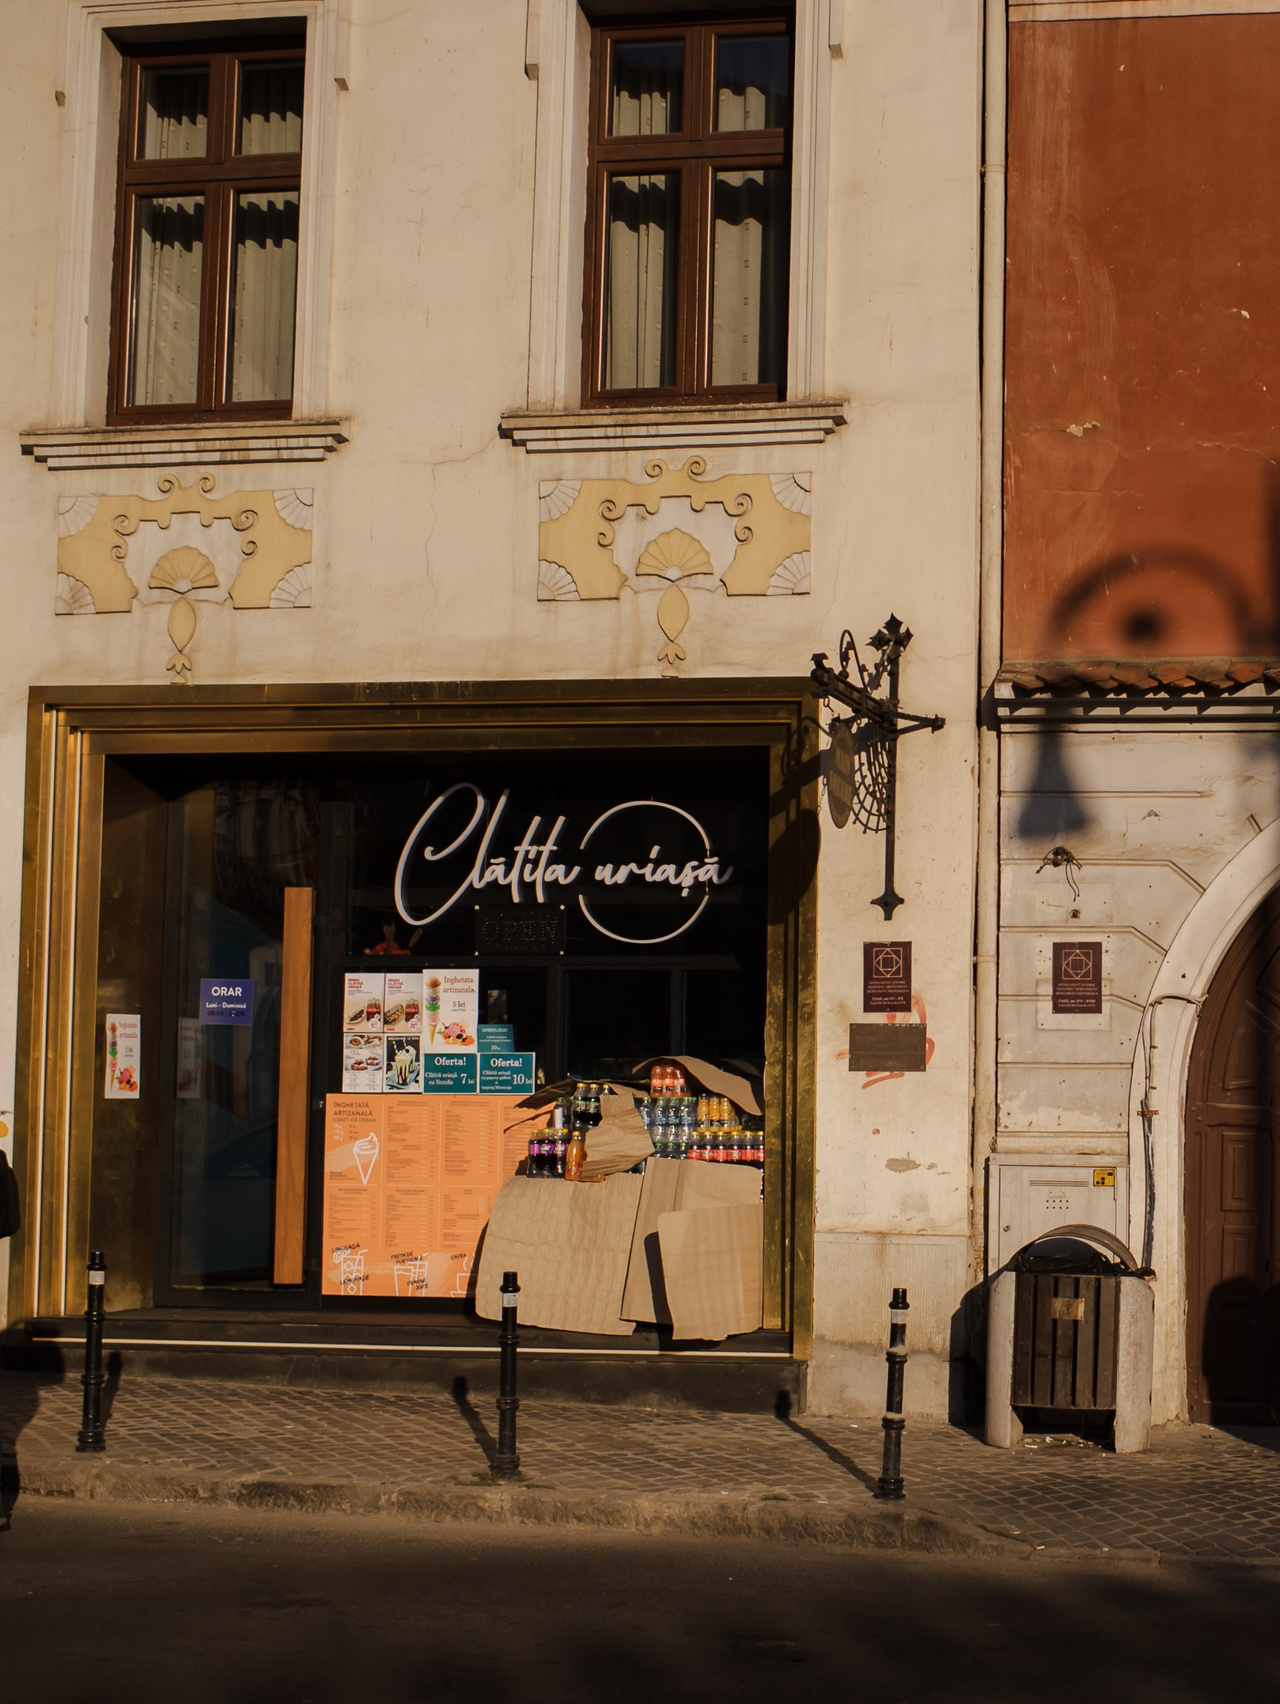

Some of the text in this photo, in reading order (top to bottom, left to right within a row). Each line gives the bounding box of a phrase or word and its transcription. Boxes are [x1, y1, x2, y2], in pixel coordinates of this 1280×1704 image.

[594, 845, 735, 898] uriașă
[482, 920, 558, 945] OPEN
[444, 976, 474, 985] Inghetata
[211, 986, 243, 997] ORAR
[457, 1000, 466, 1008] lei
[434, 1056, 467, 1066] Oferta!
[490, 1057, 523, 1067] Oferta!
[461, 1073, 468, 1084] 7
[512, 1074, 525, 1084] 10
